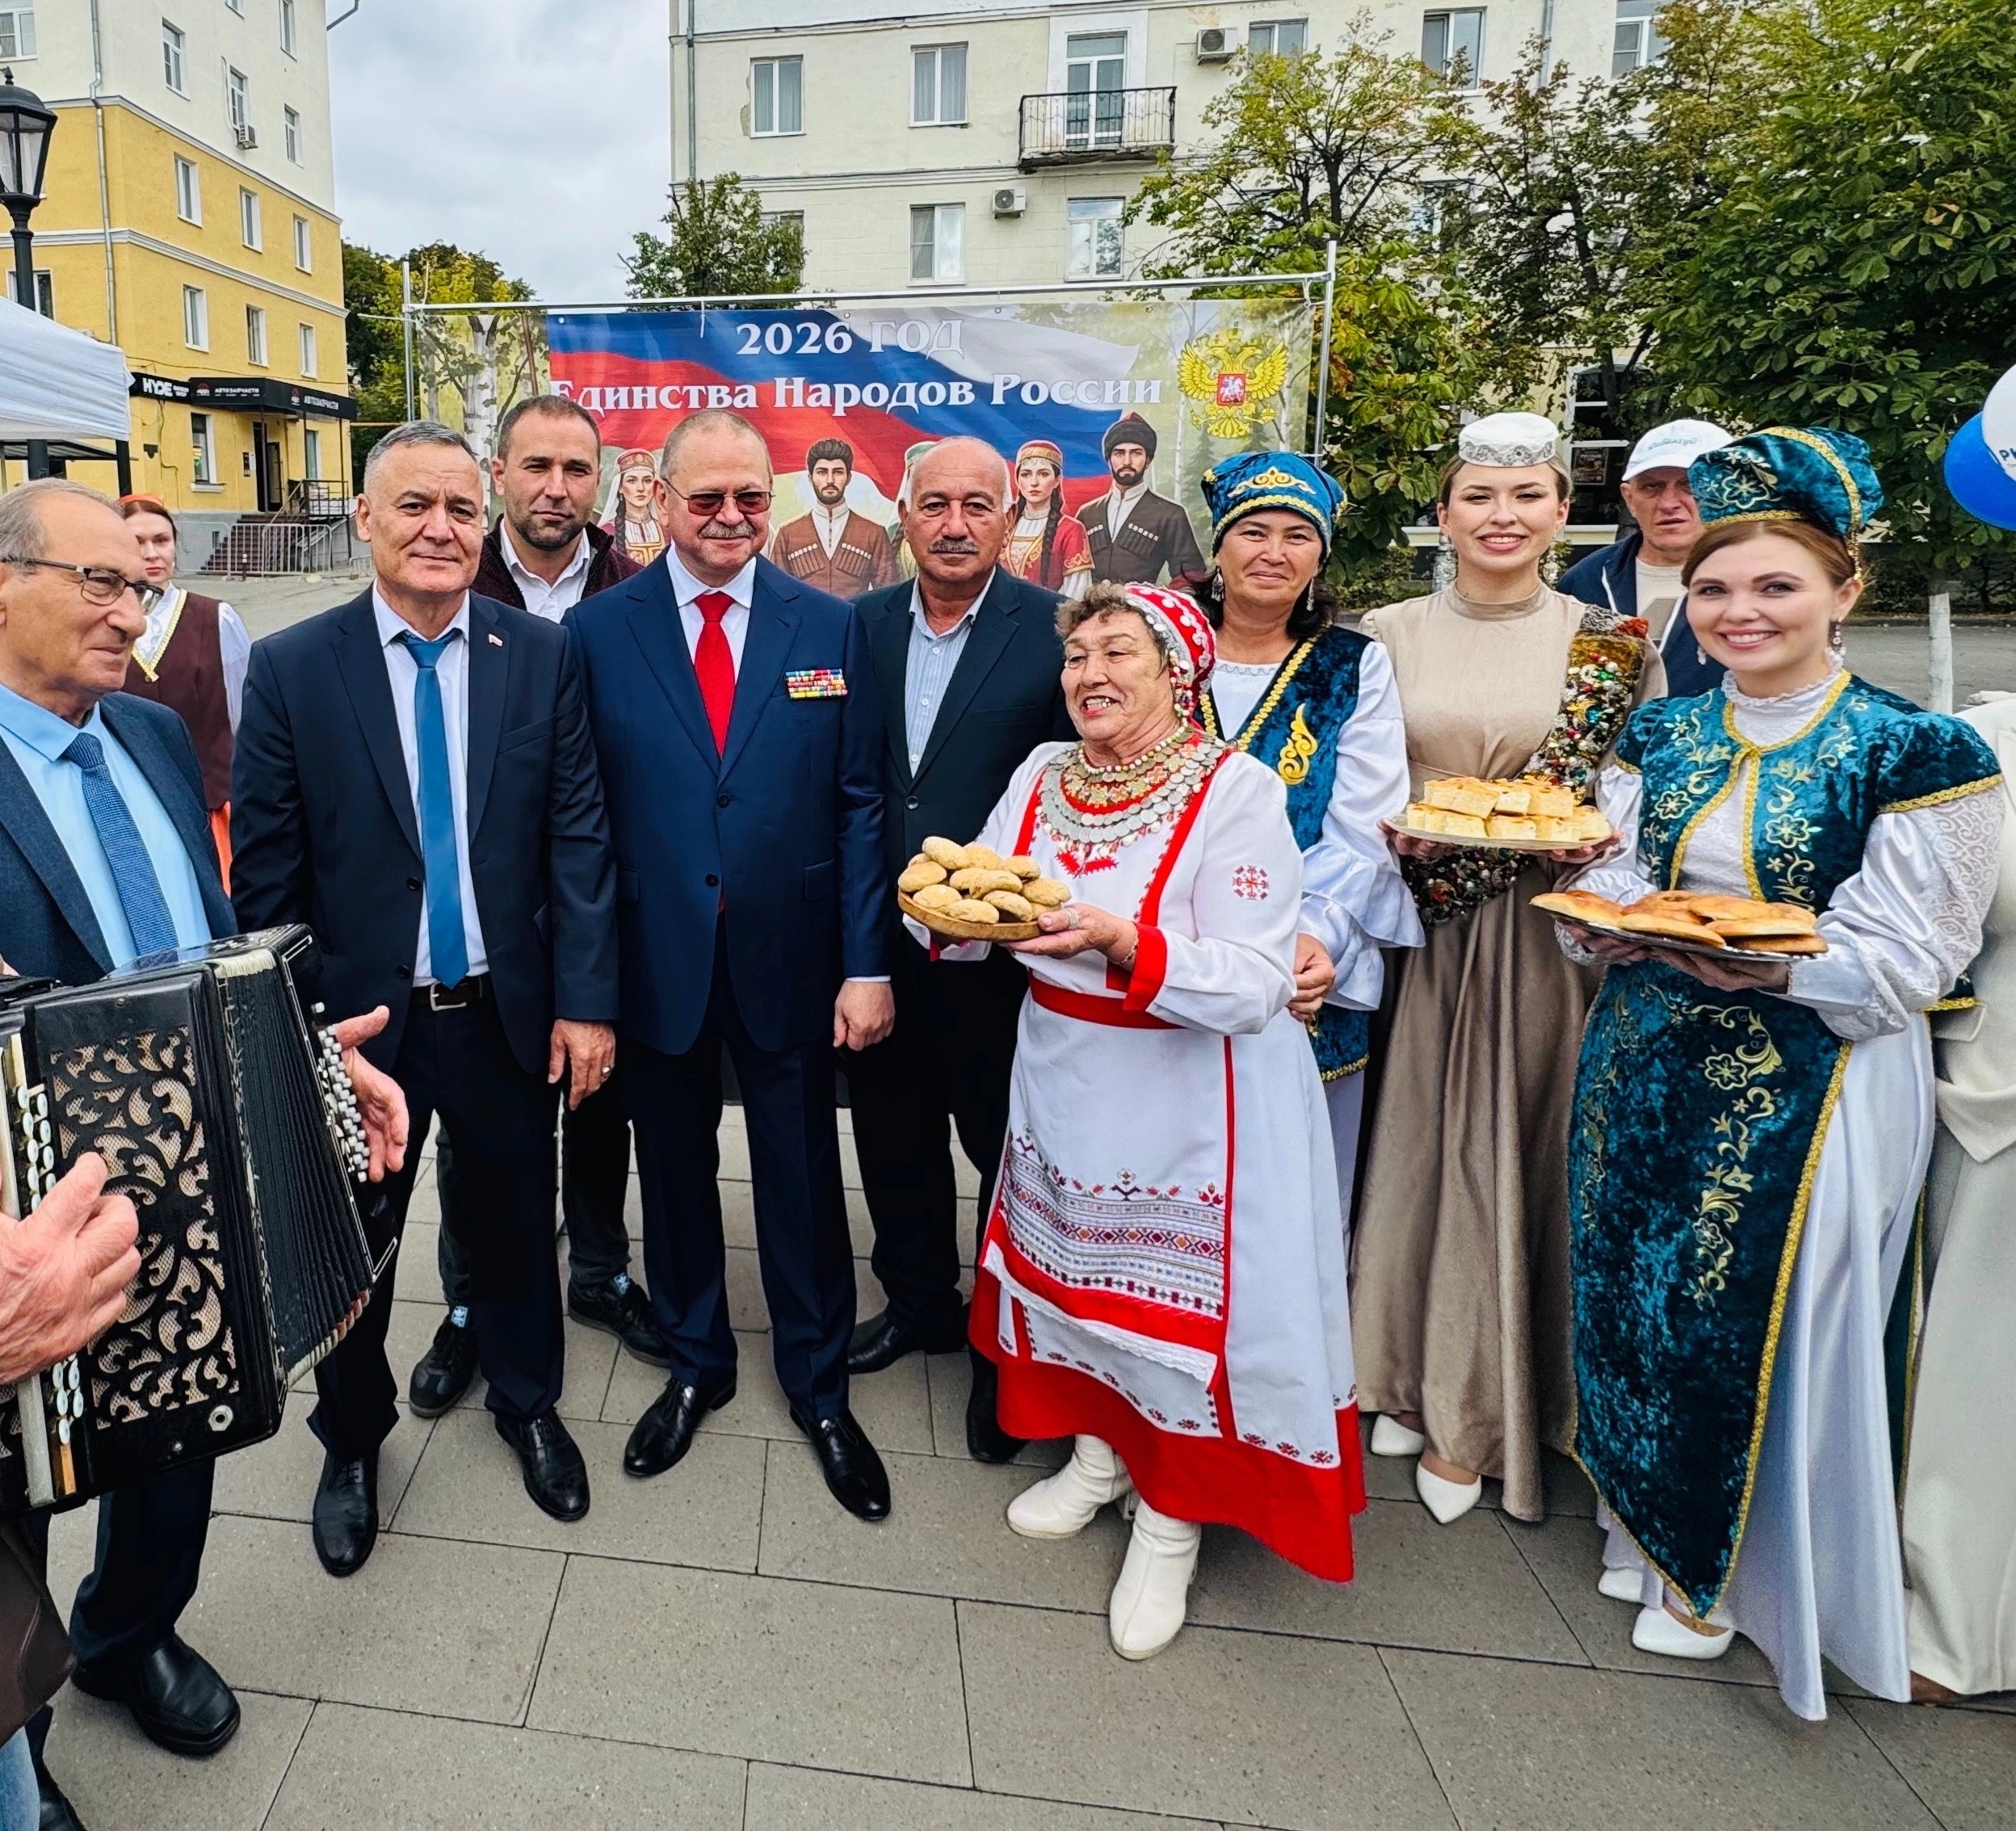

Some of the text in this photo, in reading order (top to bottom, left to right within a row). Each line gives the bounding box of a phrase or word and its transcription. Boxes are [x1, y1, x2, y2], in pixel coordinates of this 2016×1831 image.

[736, 319, 965, 360] 2026 ГОД
[142, 377, 173, 397] HYDE
[549, 373, 1163, 418] Единства Народов России
